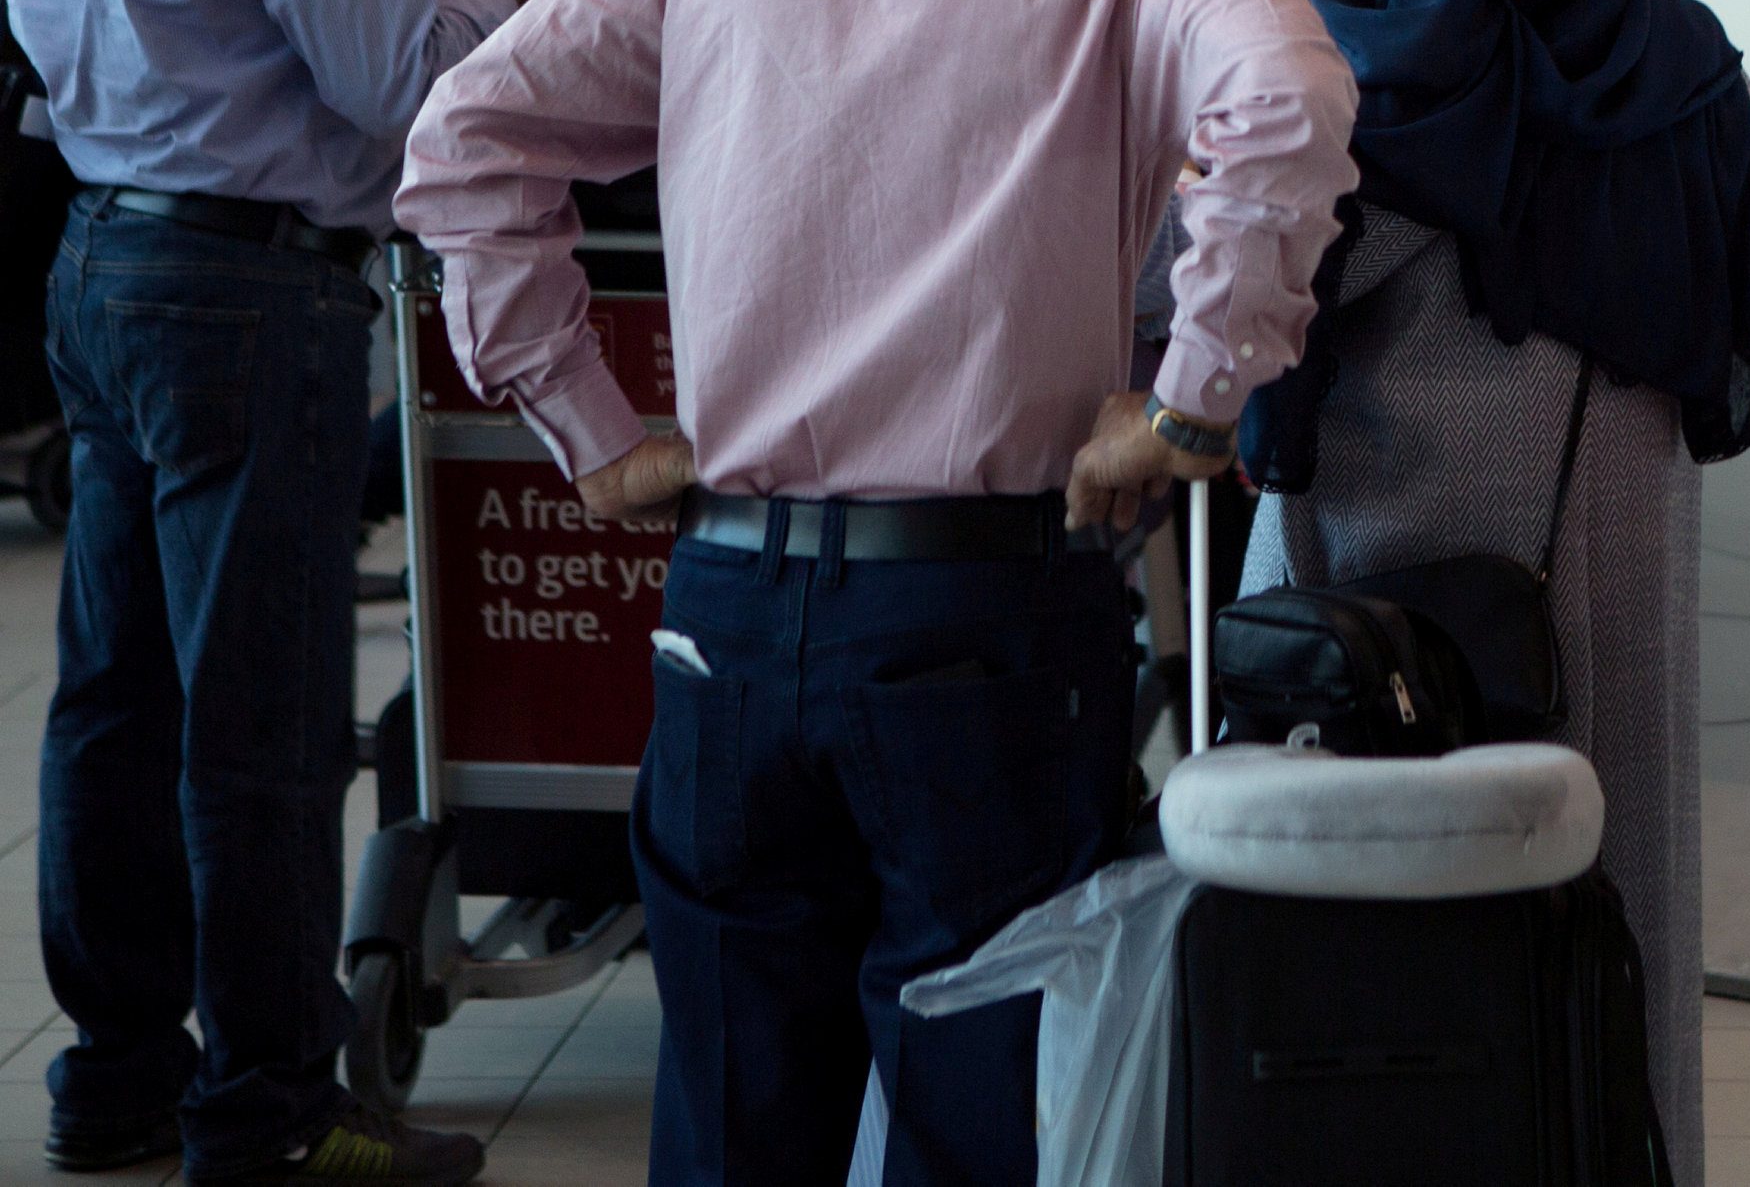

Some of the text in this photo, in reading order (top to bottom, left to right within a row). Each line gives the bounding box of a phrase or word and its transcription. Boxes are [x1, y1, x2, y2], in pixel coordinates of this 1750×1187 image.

[477, 487, 512, 530] A
[478, 547, 668, 601] to get yo
[480, 596, 611, 643] there.
